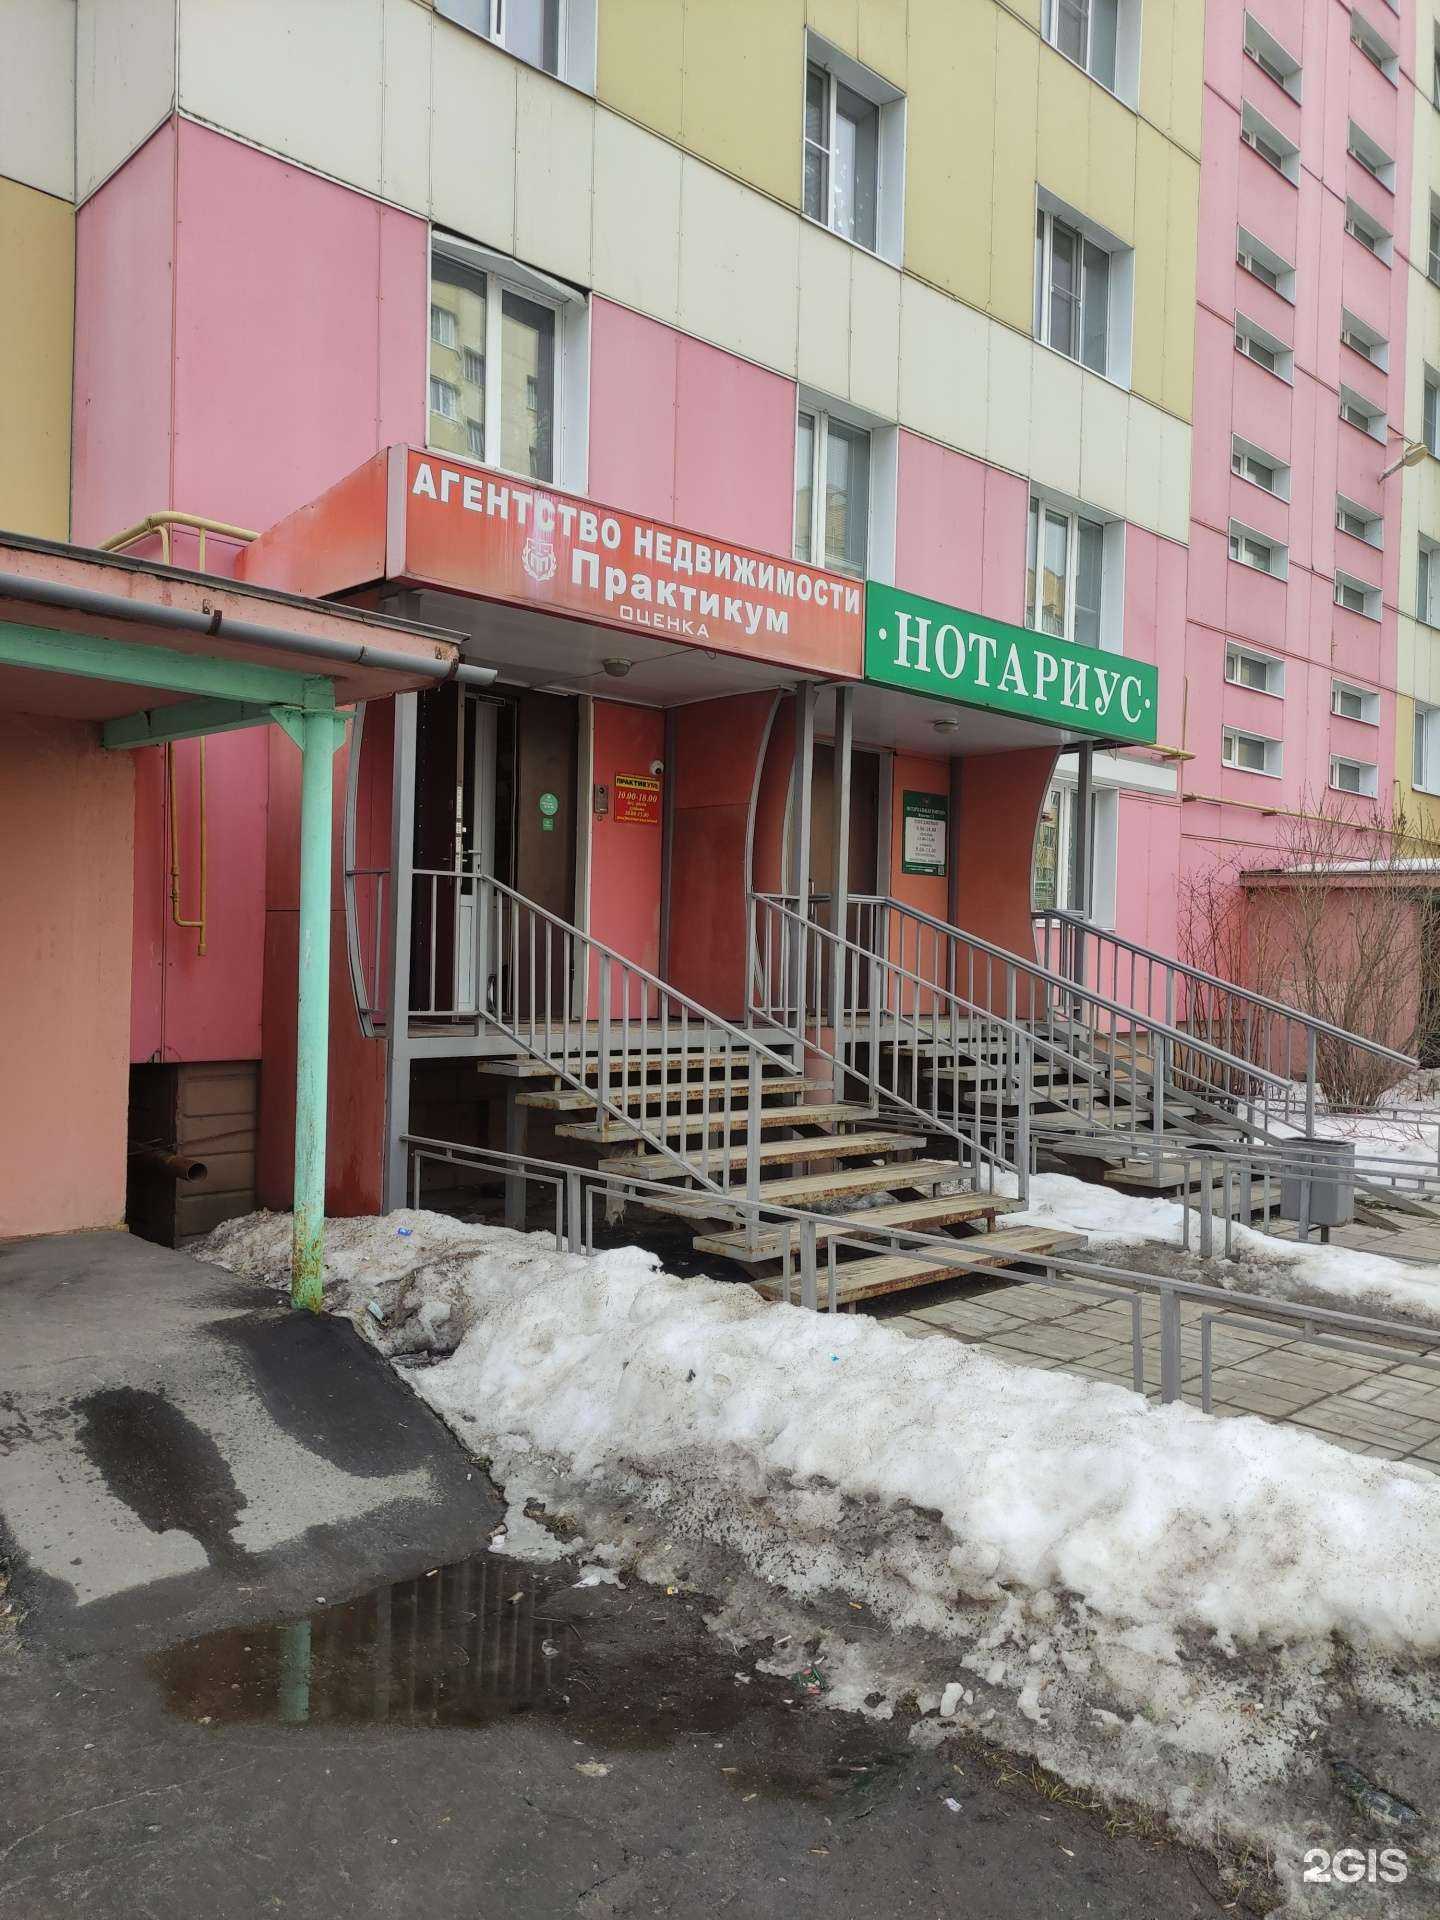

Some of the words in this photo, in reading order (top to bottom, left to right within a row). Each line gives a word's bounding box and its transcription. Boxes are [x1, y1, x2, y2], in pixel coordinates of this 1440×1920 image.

[412, 463, 621, 550] АГЕНТСТВО
[634, 526, 860, 615] НЕДВИЖИМОСТИ
[571, 550, 790, 636] Практикум
[619, 604, 710, 639] ОЦЕНКА
[893, 610, 1143, 723] НОТАРИУС
